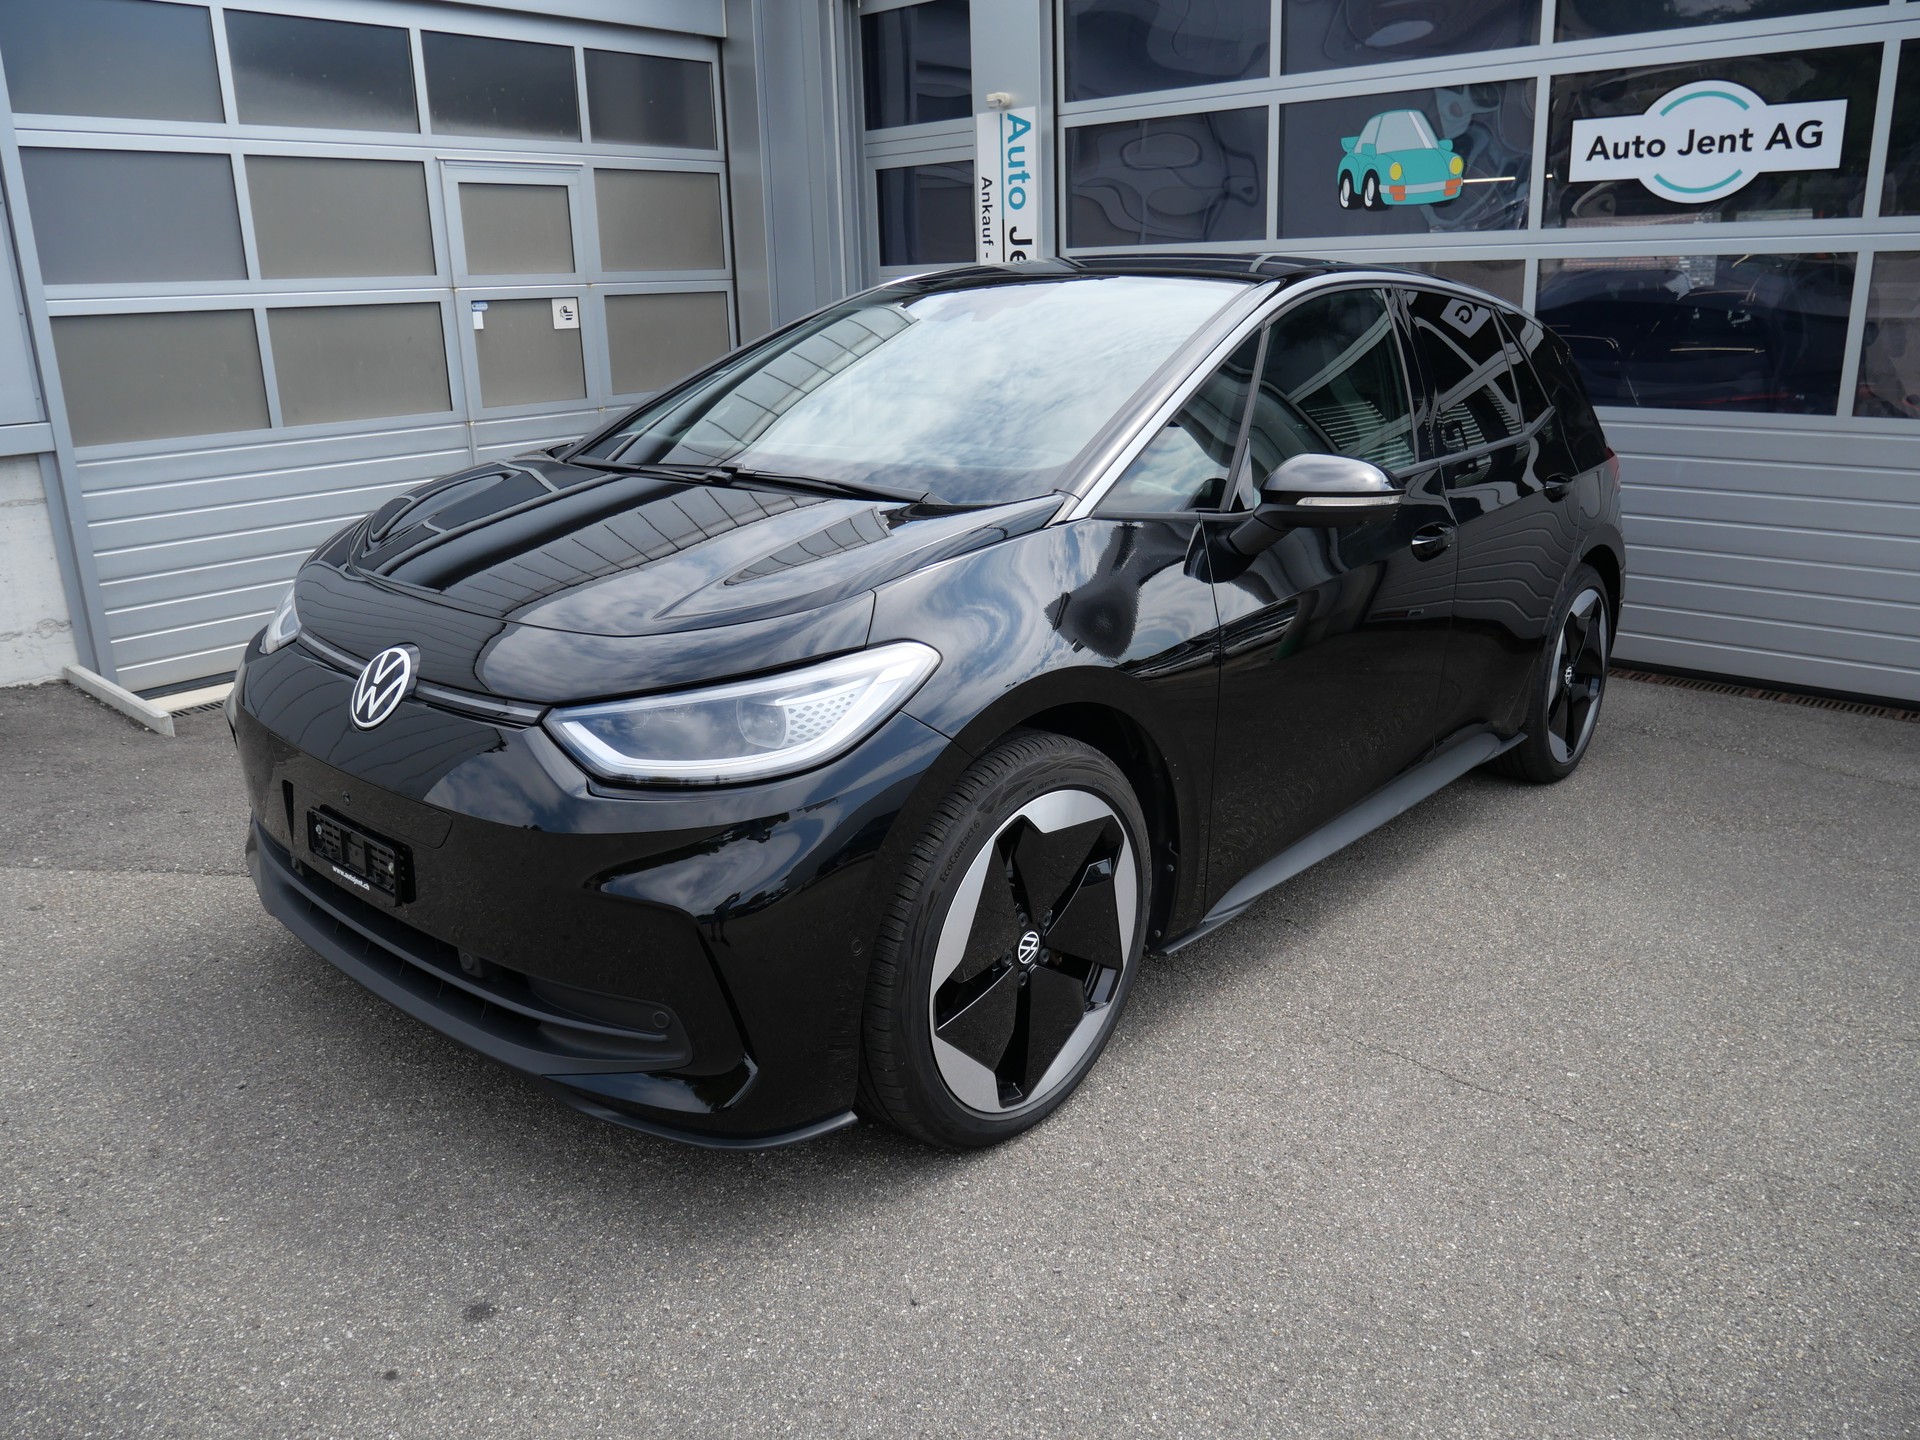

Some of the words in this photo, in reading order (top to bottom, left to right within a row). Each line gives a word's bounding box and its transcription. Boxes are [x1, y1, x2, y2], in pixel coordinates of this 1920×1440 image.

[1007, 113, 1032, 210] Auto
[1586, 136, 1666, 162] Auto
[1677, 128, 1754, 156] Jent
[1765, 120, 1824, 151] AG
[981, 177, 994, 246] Ankauf
[939, 827, 976, 883] EcoContact
[973, 819, 981, 830] 6
